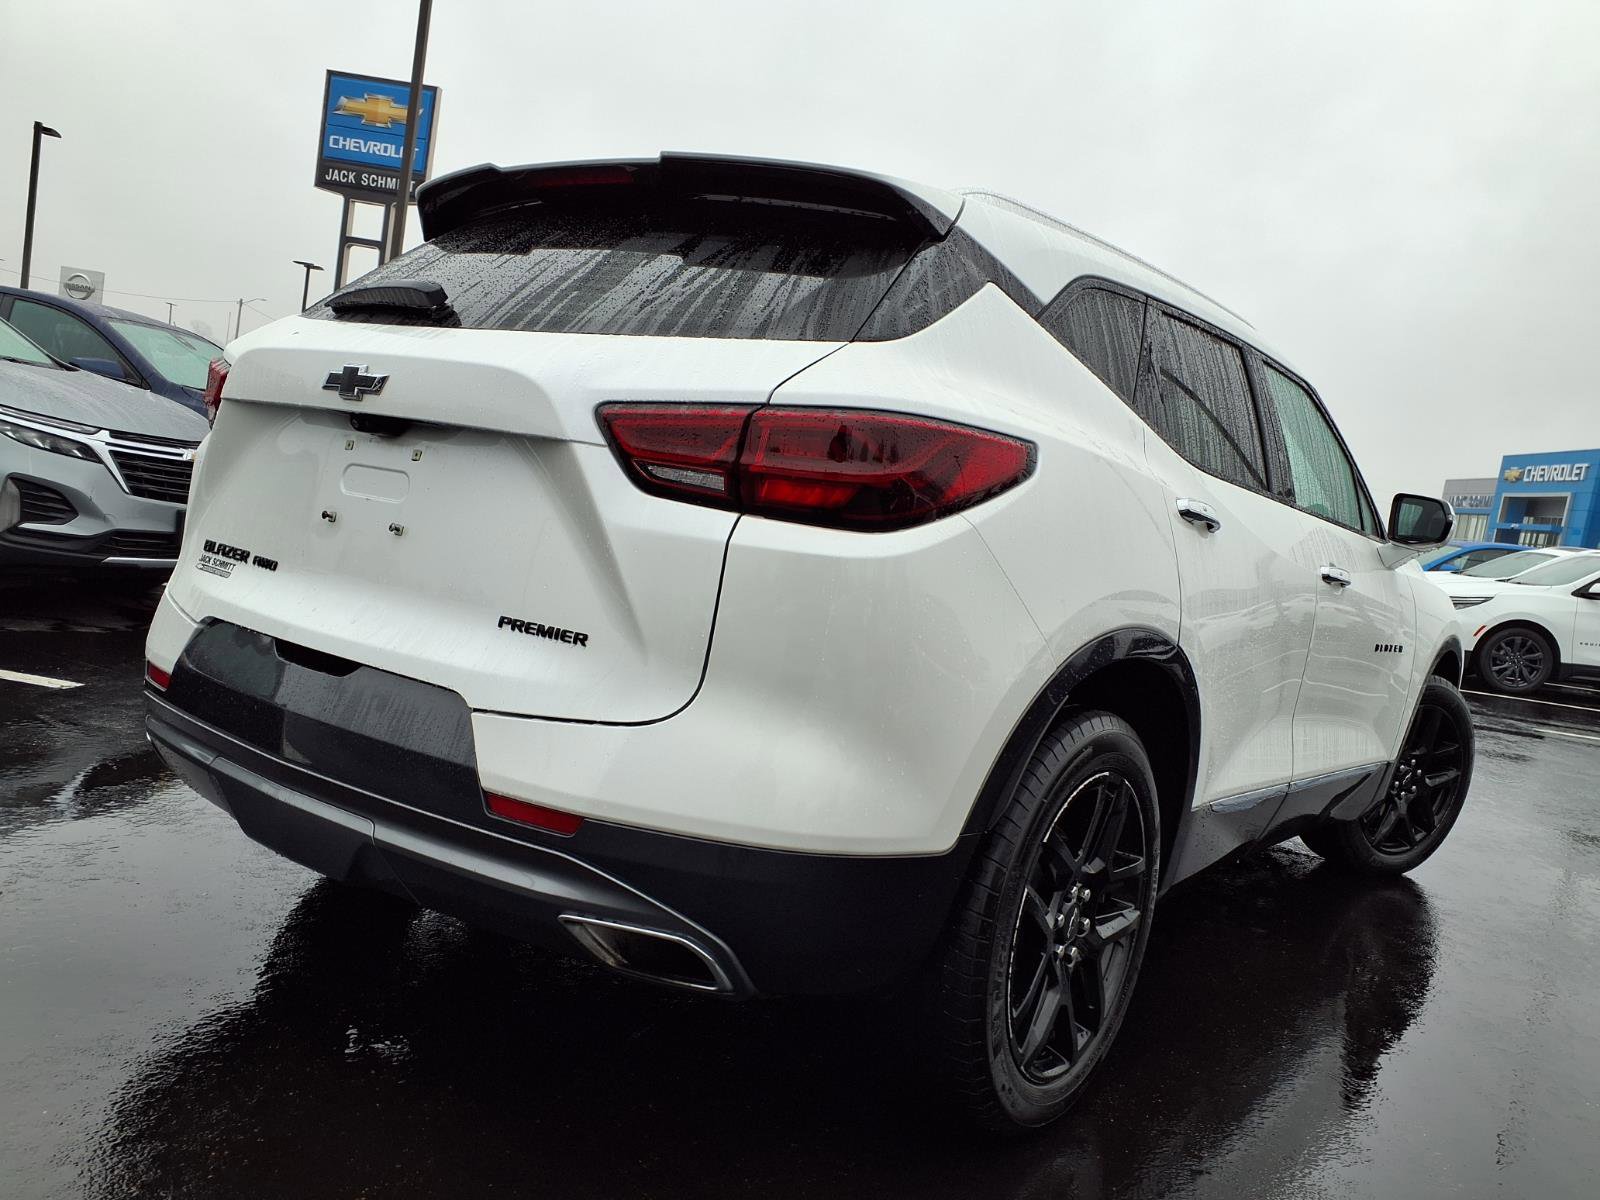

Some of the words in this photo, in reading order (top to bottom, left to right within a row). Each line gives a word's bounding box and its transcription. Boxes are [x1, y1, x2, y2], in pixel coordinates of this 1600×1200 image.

[329, 135, 420, 160] CHEVROLT
[325, 168, 356, 184] JACK
[361, 173, 415, 192] SCHMIT
[1523, 463, 1590, 482] CHEVROLET
[203, 539, 250, 564] BLAZER
[498, 615, 589, 647] PREMIER
